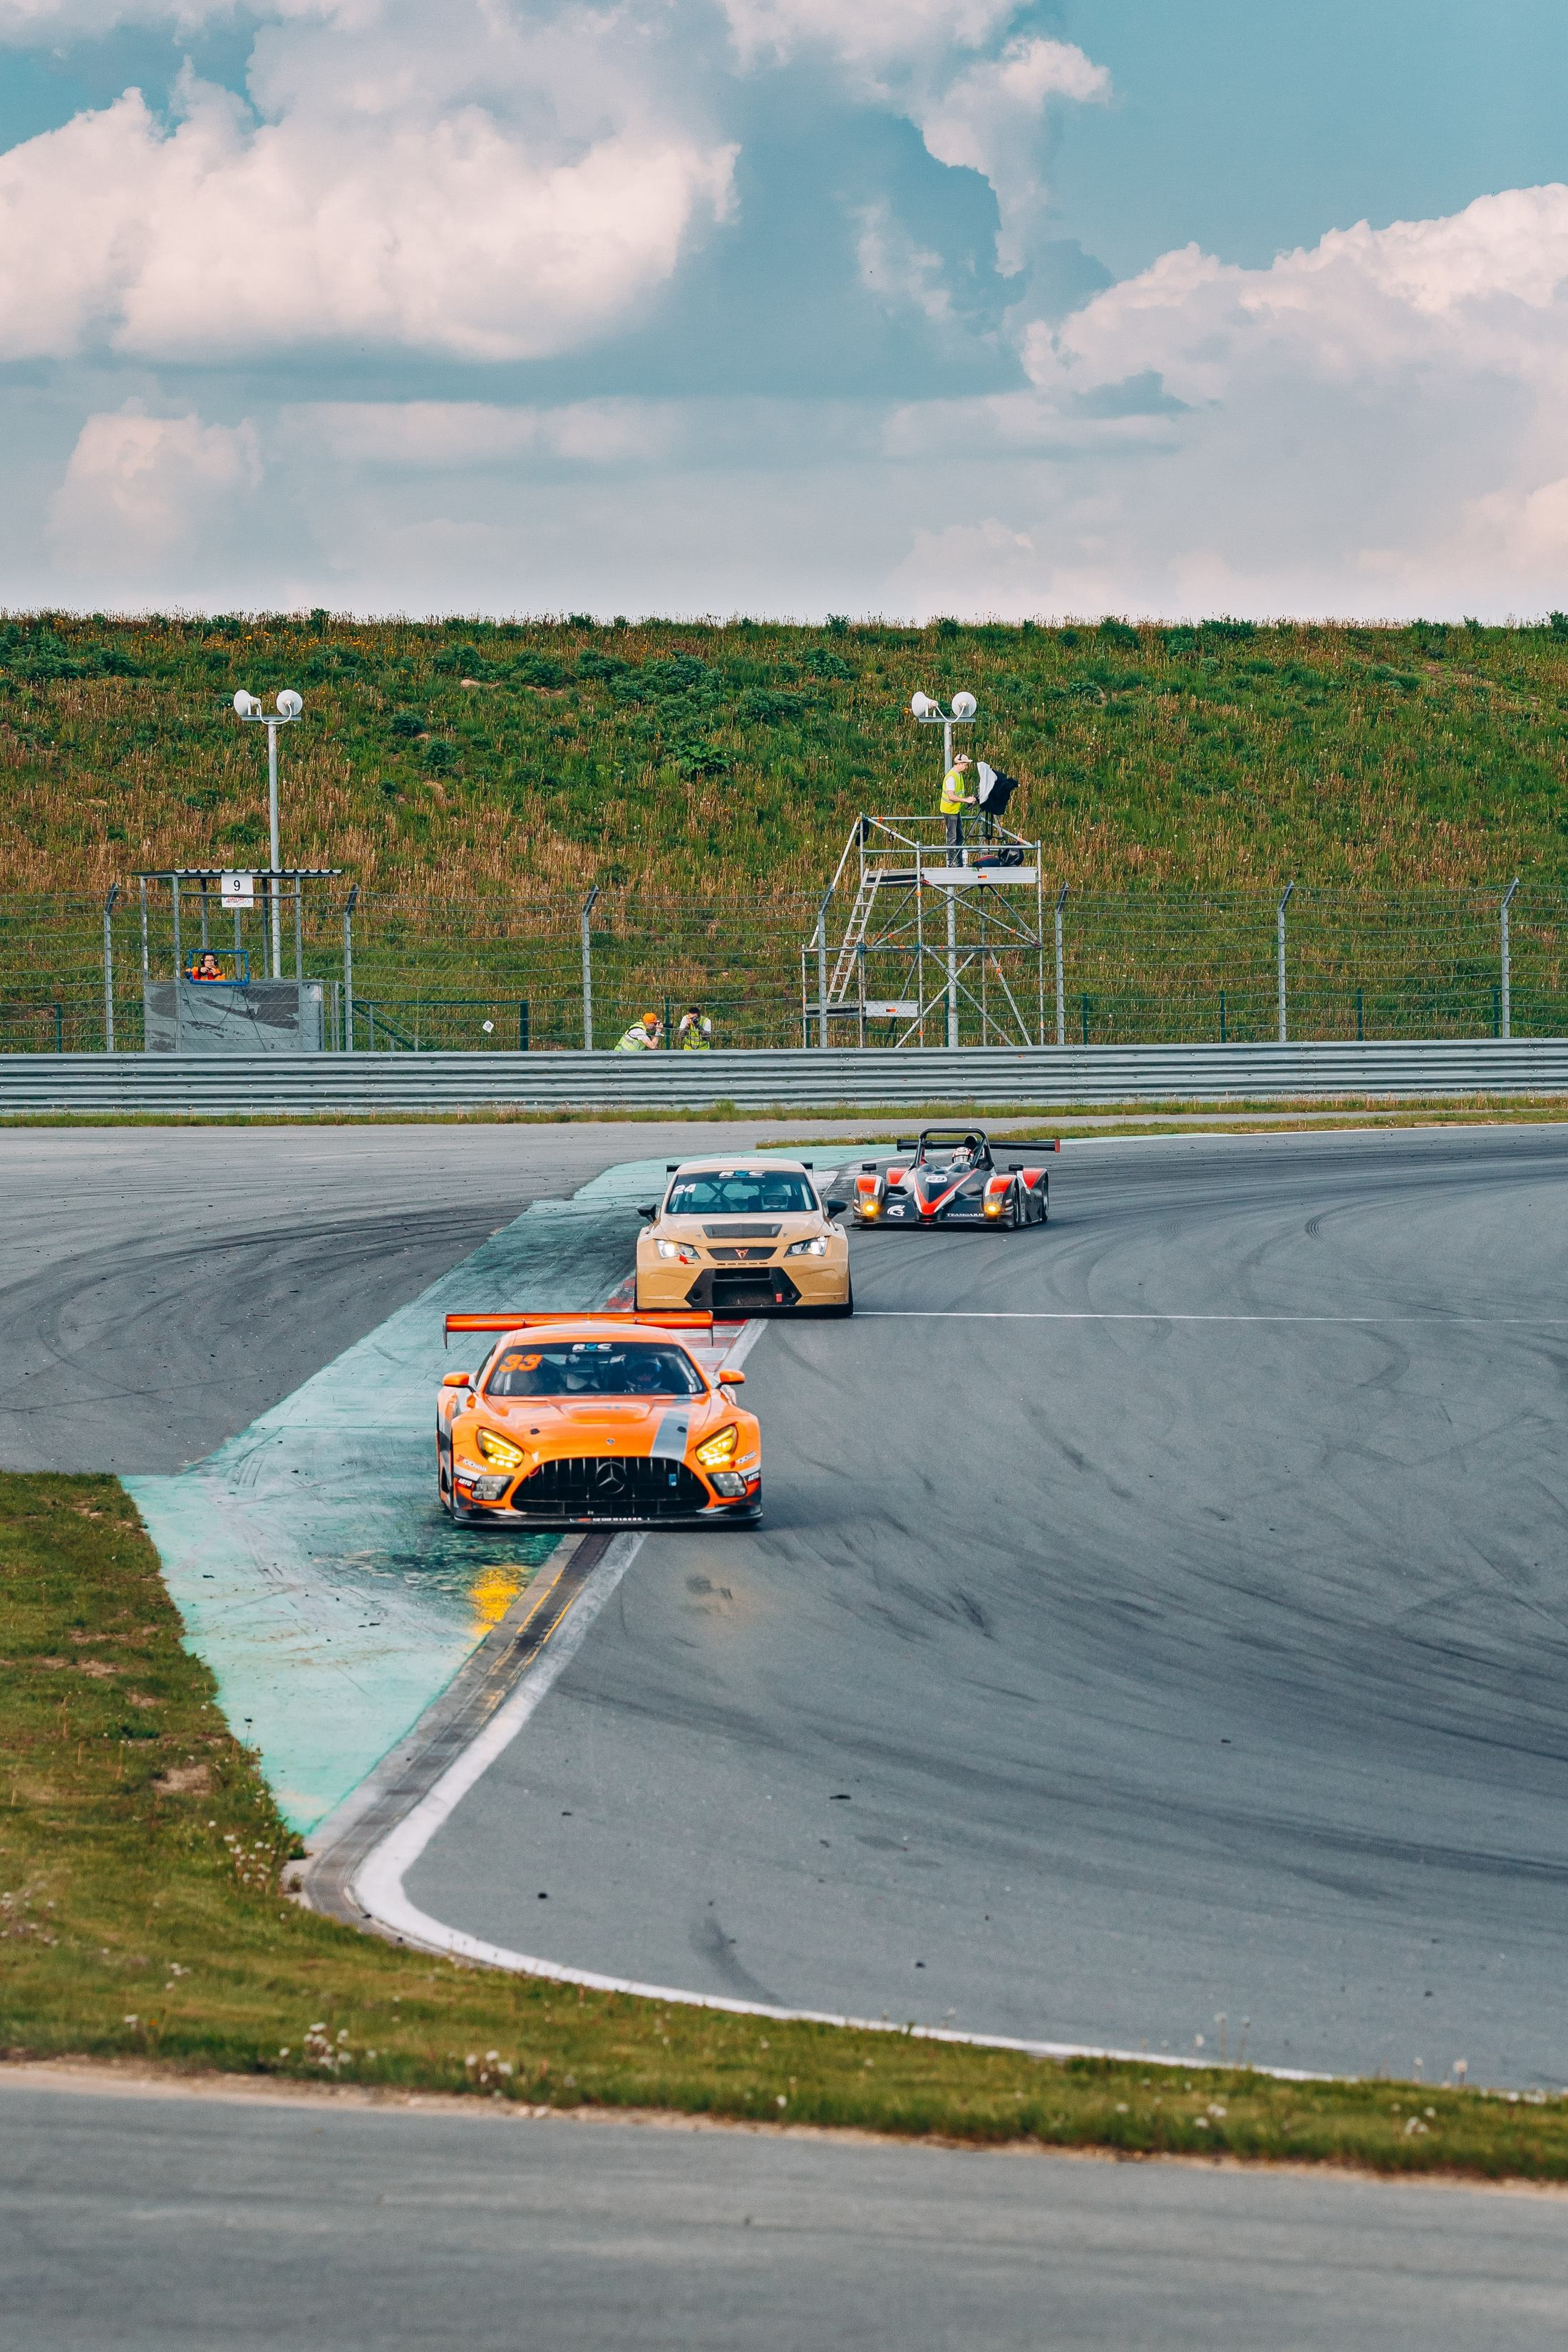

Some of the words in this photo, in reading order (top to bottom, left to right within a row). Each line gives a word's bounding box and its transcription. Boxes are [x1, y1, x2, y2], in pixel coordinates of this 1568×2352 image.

[234, 880, 241, 892] 9
[672, 1183, 696, 1195] 24
[498, 1353, 542, 1372] 33
